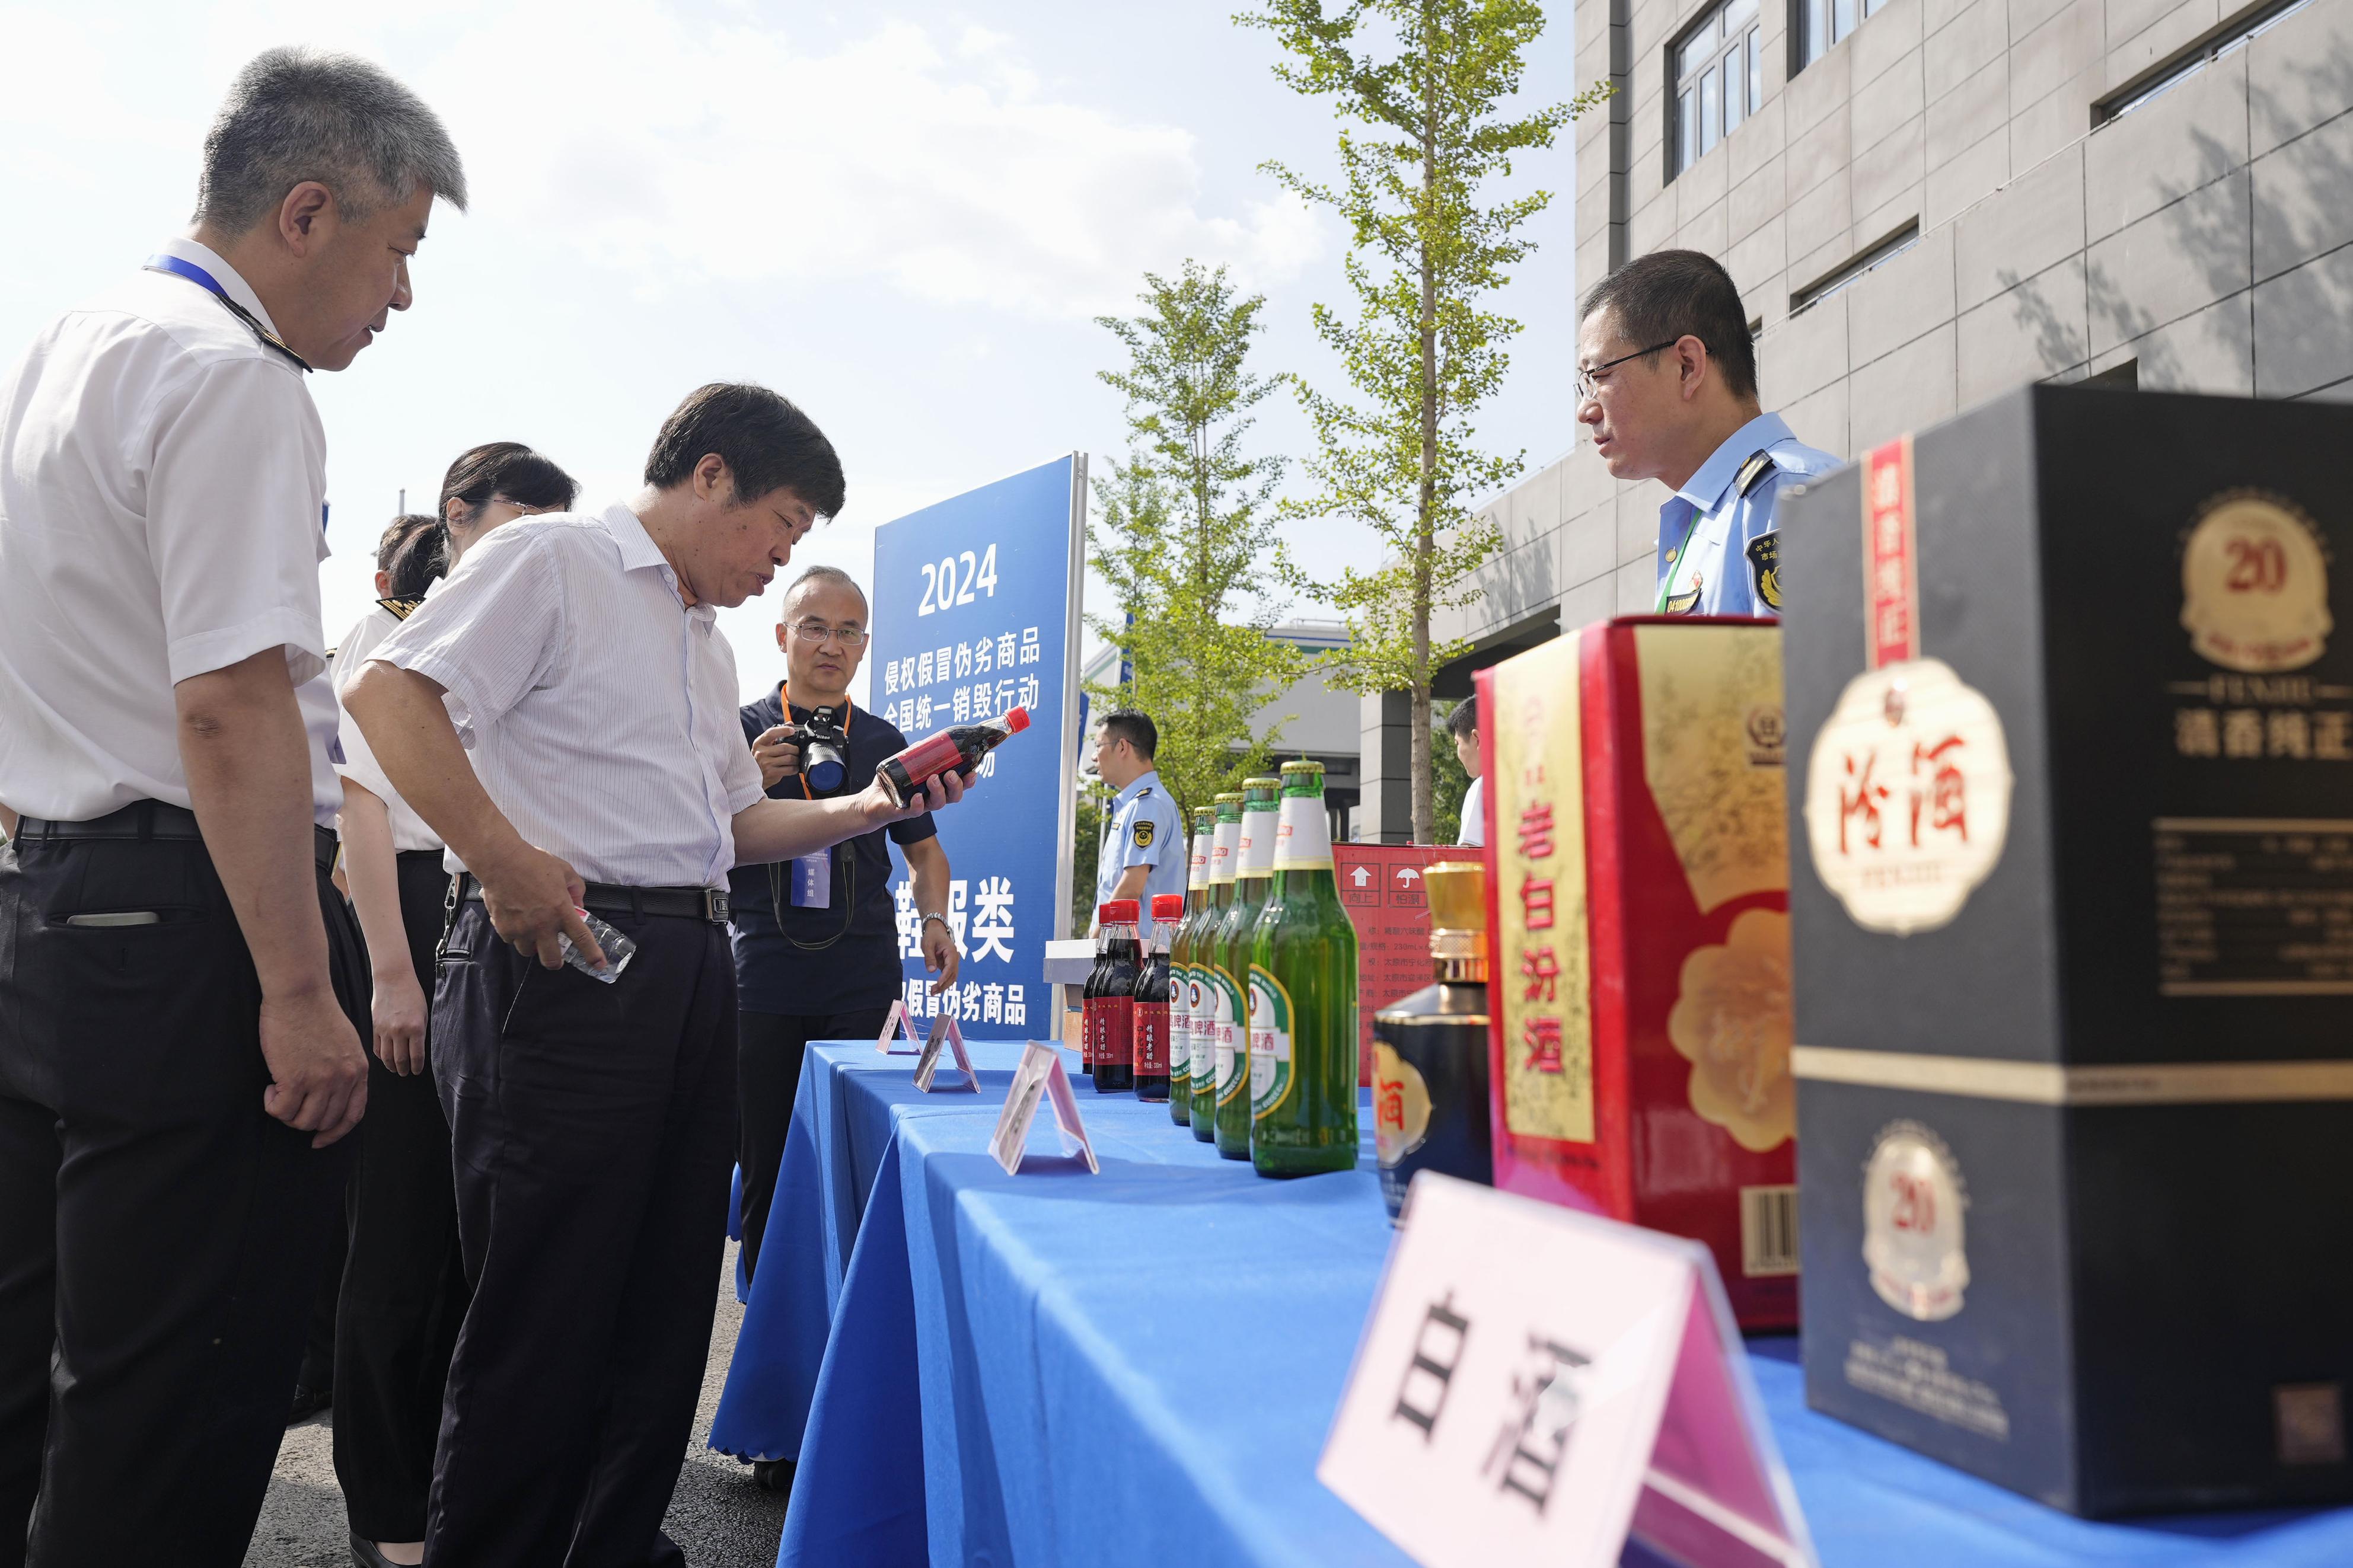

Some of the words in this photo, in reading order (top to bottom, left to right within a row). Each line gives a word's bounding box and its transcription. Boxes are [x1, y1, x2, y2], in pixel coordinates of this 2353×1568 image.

[918, 542, 998, 617] 2024
[1761, 550, 1781, 561] 市场
[2224, 535, 2288, 595] 20
[884, 626, 1041, 697] 侵权假冒伪劣商品
[882, 673, 1040, 734] 全国统一销毁行动
[806, 867, 815, 898] 媒体组
[1349, 892, 1373, 903] 向上
[901, 978, 1026, 1026] 假冒伪劣商品
[1146, 1024, 1154, 1061] 精酿老醋
